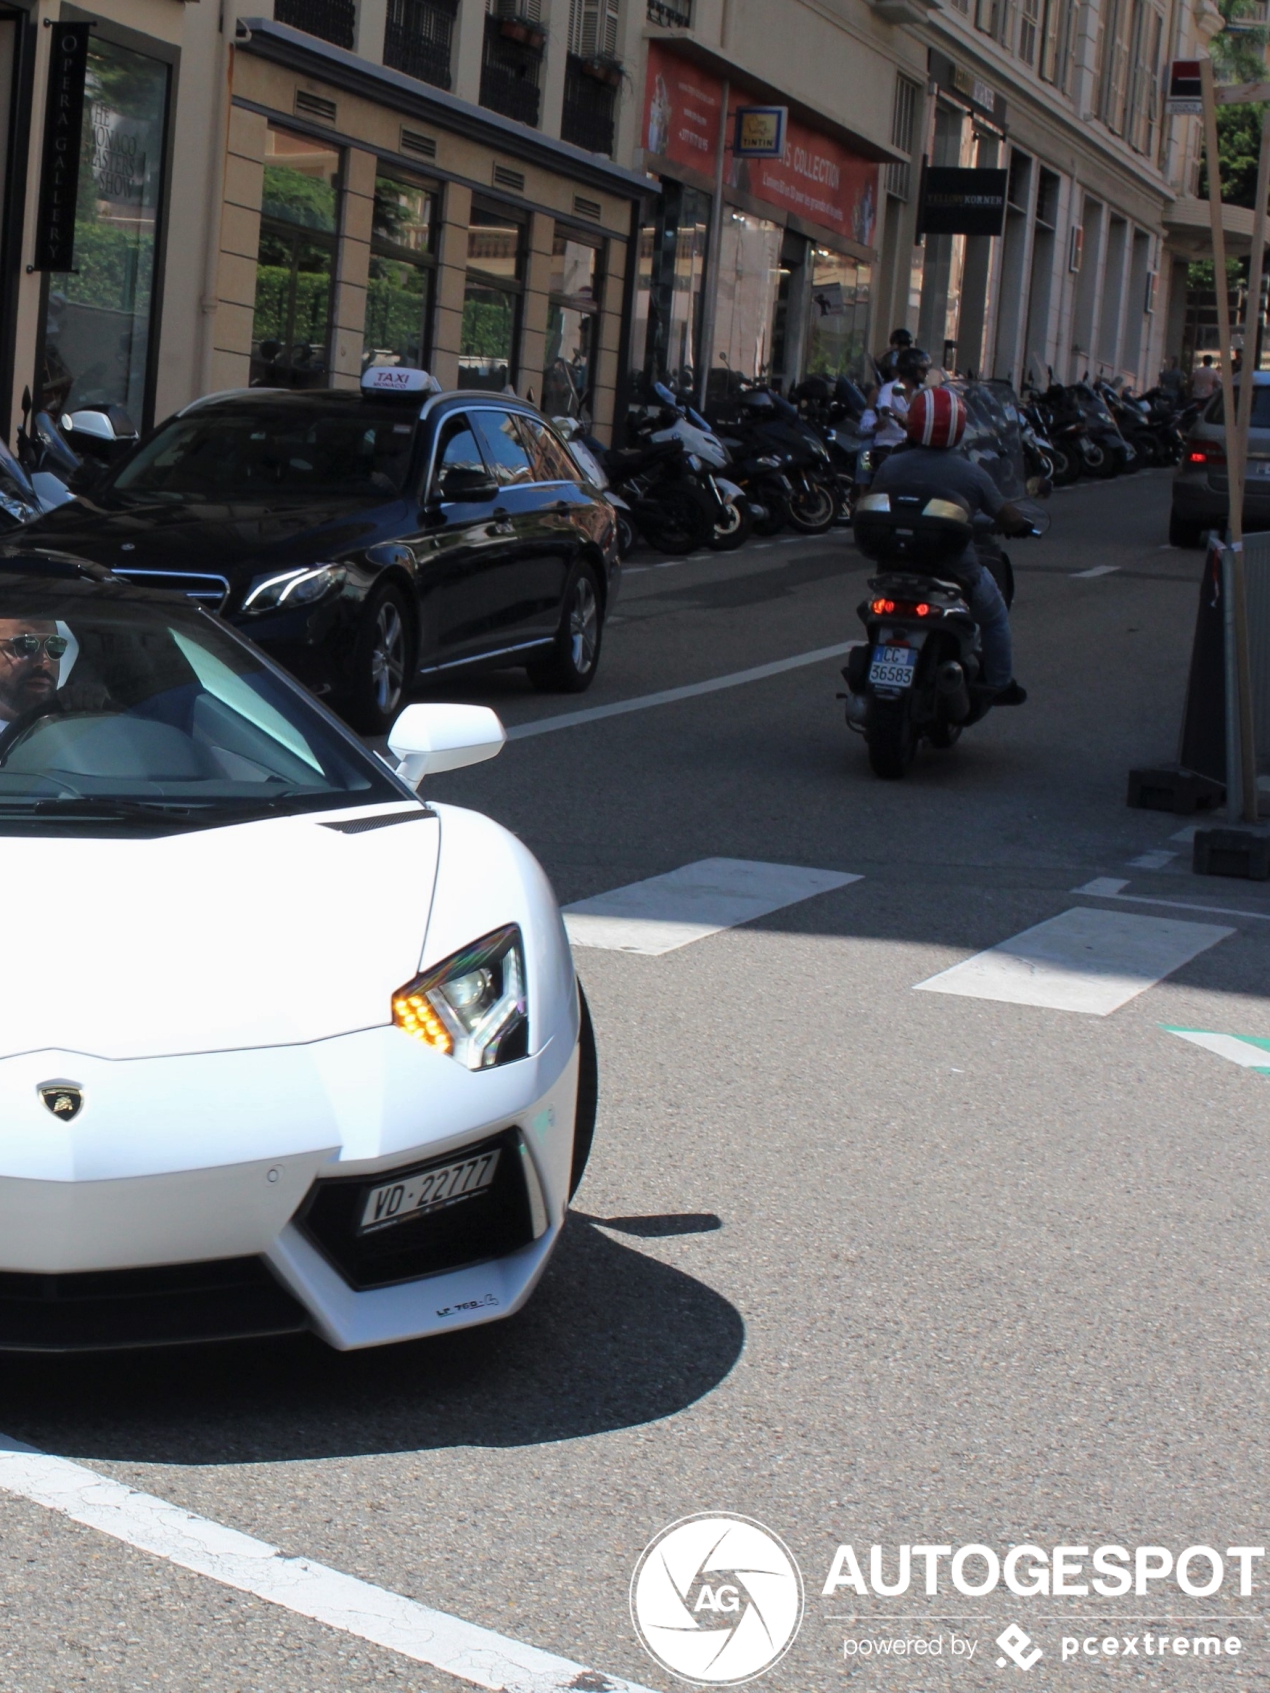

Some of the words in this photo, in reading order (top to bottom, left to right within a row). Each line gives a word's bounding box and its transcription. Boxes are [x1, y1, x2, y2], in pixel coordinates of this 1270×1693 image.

[57, 34, 78, 126] OPERA
[743, 138, 774, 147] TINTIN
[793, 147, 840, 190] COLLECTION
[48, 137, 68, 259] GALLERY
[98, 170, 135, 198] SHOW
[378, 372, 410, 384] TAXI
[871, 664, 912, 684] 36583
